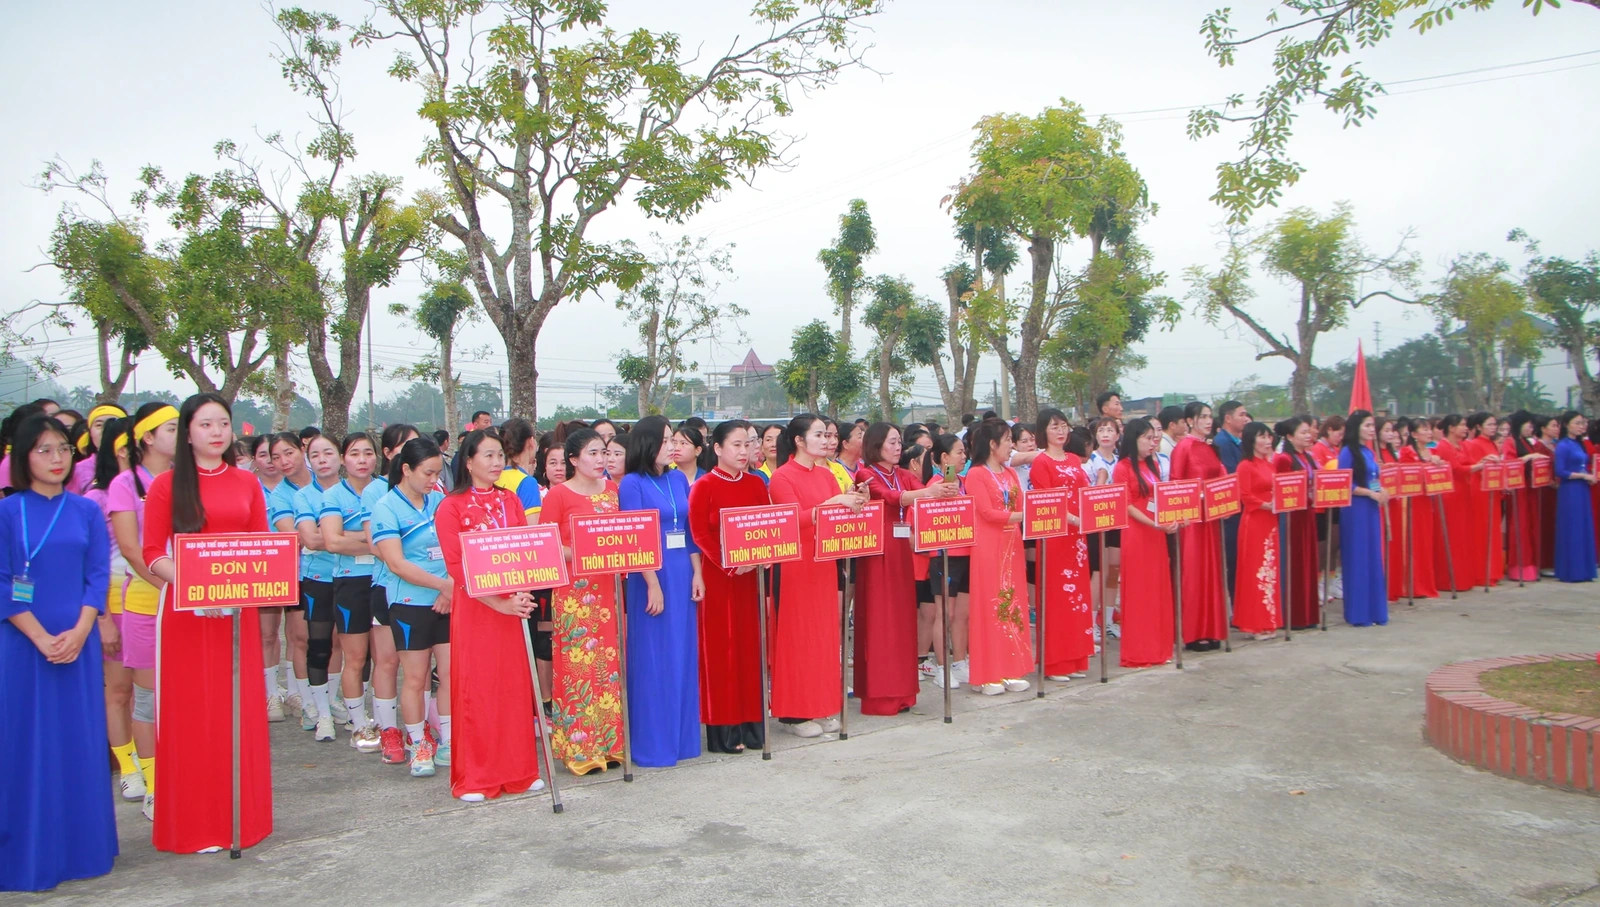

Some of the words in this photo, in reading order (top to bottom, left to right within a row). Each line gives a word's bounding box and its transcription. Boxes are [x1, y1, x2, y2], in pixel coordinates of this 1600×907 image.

[1036, 506, 1050, 516] ĐƠN
[1051, 506, 1057, 515] VỊ
[1094, 501, 1108, 511] ĐƠN
[1109, 501, 1116, 510] VỊ
[933, 515, 950, 525] ĐƠN
[953, 515, 960, 524] VỊ
[745, 529, 767, 540] ĐƠN
[771, 528, 780, 539] VỊ
[835, 522, 854, 533] ĐƠN
[858, 522, 866, 532] VỊ
[920, 528, 936, 544] THÔN
[937, 528, 956, 544] THẠCH
[957, 525, 973, 539] ĐÔNG
[597, 534, 622, 546] ĐƠN
[626, 534, 637, 546] VỊ
[822, 536, 839, 553] THÔN
[842, 536, 862, 553] THẠCH
[864, 530, 877, 548] BẮC
[492, 552, 520, 564] ĐƠN
[524, 550, 537, 562] VỊ
[581, 553, 604, 570] THÔN
[606, 551, 625, 568] TIÊN
[627, 547, 654, 566] THẮNG
[730, 547, 750, 563] THÔN
[752, 544, 771, 560] PHÚC
[773, 541, 797, 557] THÀNH
[211, 561, 246, 575] ĐƠN
[253, 561, 267, 575] VỊ
[474, 571, 501, 589] THÔN
[503, 568, 525, 586] TIÊN
[526, 567, 559, 583] PHONG
[188, 586, 204, 601] GD
[209, 579, 248, 601] QUẢNG
[252, 582, 288, 600] THẠCH
